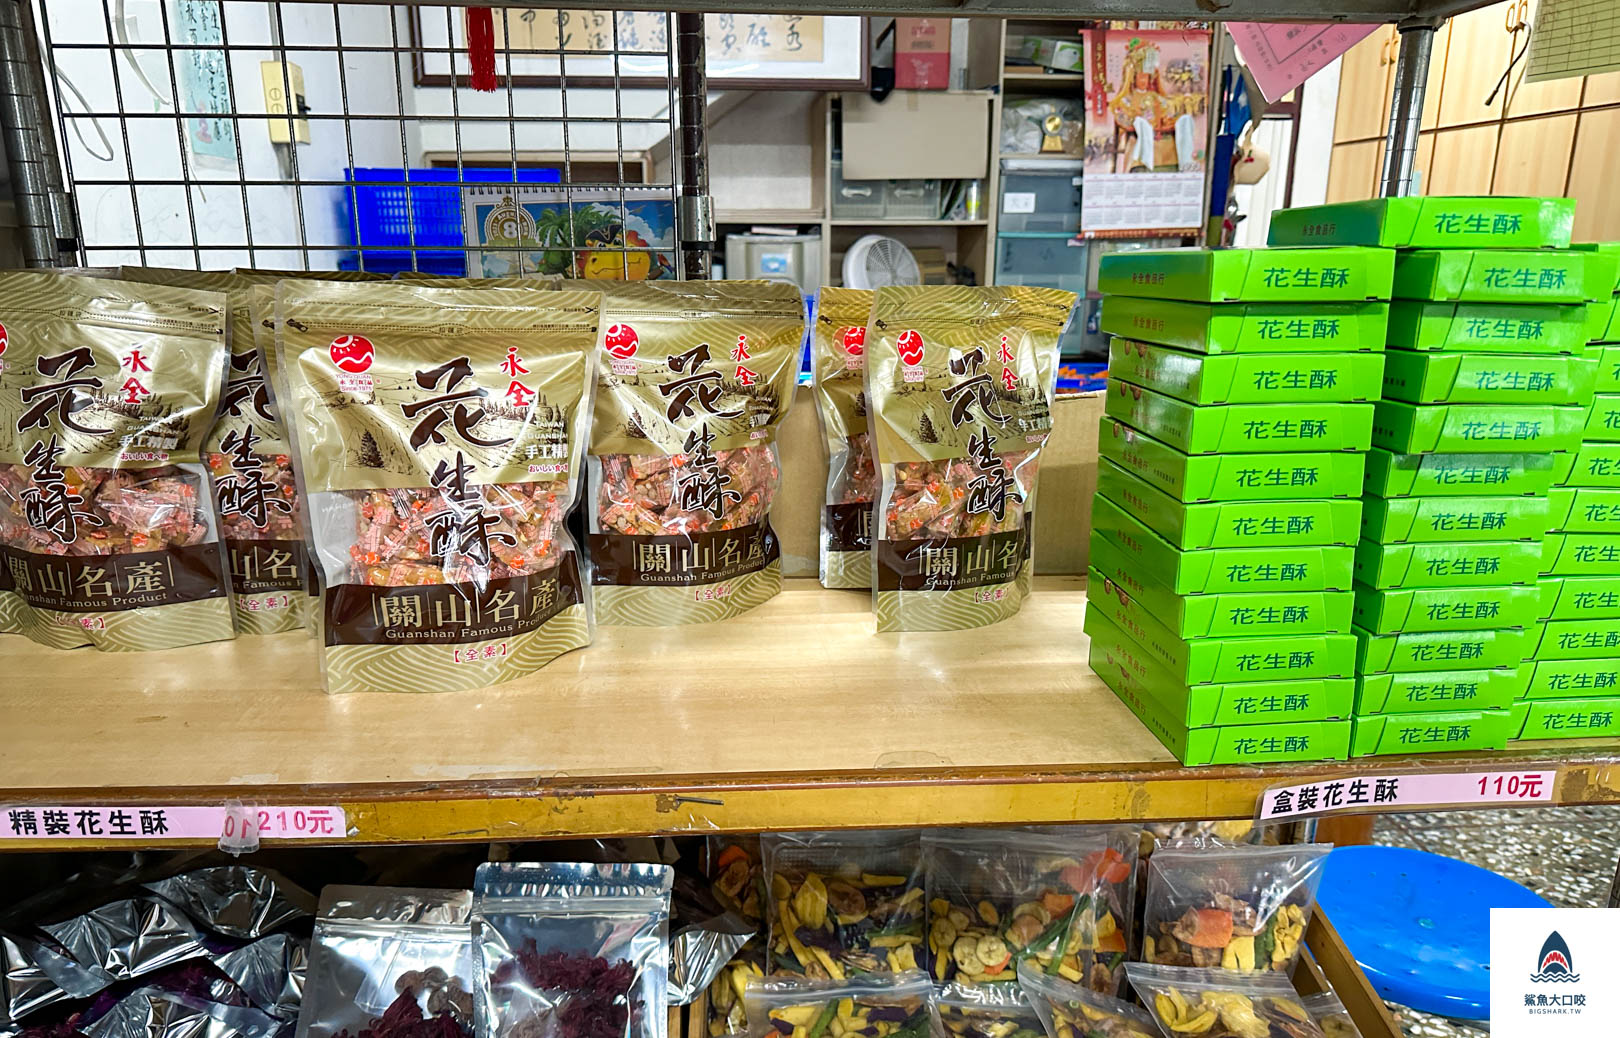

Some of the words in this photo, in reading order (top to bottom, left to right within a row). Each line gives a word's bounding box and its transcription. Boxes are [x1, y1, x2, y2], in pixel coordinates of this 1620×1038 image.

[1434, 213, 1521, 235] 花生酥
[1263, 267, 1350, 289] 花生酥
[1484, 268, 1568, 290] 花生酥
[1257, 319, 1340, 340] 花生酥
[1466, 319, 1545, 340] 花生酥
[730, 335, 759, 387] 永全
[996, 336, 1019, 391] 永全
[500, 346, 536, 408] 永全
[1253, 369, 1337, 390] 花生酥
[1475, 371, 1556, 392] 花生酥
[658, 343, 746, 520] 花生酥
[1244, 419, 1327, 440] 花生酥
[1462, 421, 1542, 441] 花生酥
[17, 346, 116, 544] 花生酥
[400, 355, 517, 567] 花生酥
[1236, 467, 1319, 488] 花生酥
[1434, 465, 1511, 485] 花生酥
[1233, 515, 1315, 536] 花生酥
[1431, 511, 1508, 531] 花生酥
[639, 536, 764, 573] 關山名產
[8, 556, 166, 598] 關山名產
[641, 574, 697, 583] Guanshan
[701, 567, 736, 581] Famous
[1226, 563, 1309, 583] 花生酥
[1426, 557, 1501, 576] 花生酥
[243, 580, 292, 589] Famous
[60, 598, 107, 608] Famous
[113, 592, 168, 606] Product
[384, 578, 557, 629] 關山名產
[1427, 601, 1502, 620] 花生酥
[1230, 606, 1309, 626] 花生酥
[386, 628, 455, 640] Guanshan
[461, 624, 513, 639] Famous
[454, 643, 507, 663] 【全素】
[1236, 650, 1315, 672] 花生酥
[1411, 642, 1485, 662] 花生酥
[1548, 672, 1618, 690] 花生酥
[1406, 683, 1478, 702] 花生酥
[1234, 694, 1310, 714] 花生酥
[1543, 712, 1614, 730] 花生酥
[1399, 725, 1472, 744] 花生酥
[1234, 736, 1310, 755] 花生酥
[1271, 778, 1400, 815] 盒裝花生酥
[1478, 774, 1544, 798] 110元
[8, 809, 169, 836] 精裝花生酥
[258, 810, 334, 834] 210元
